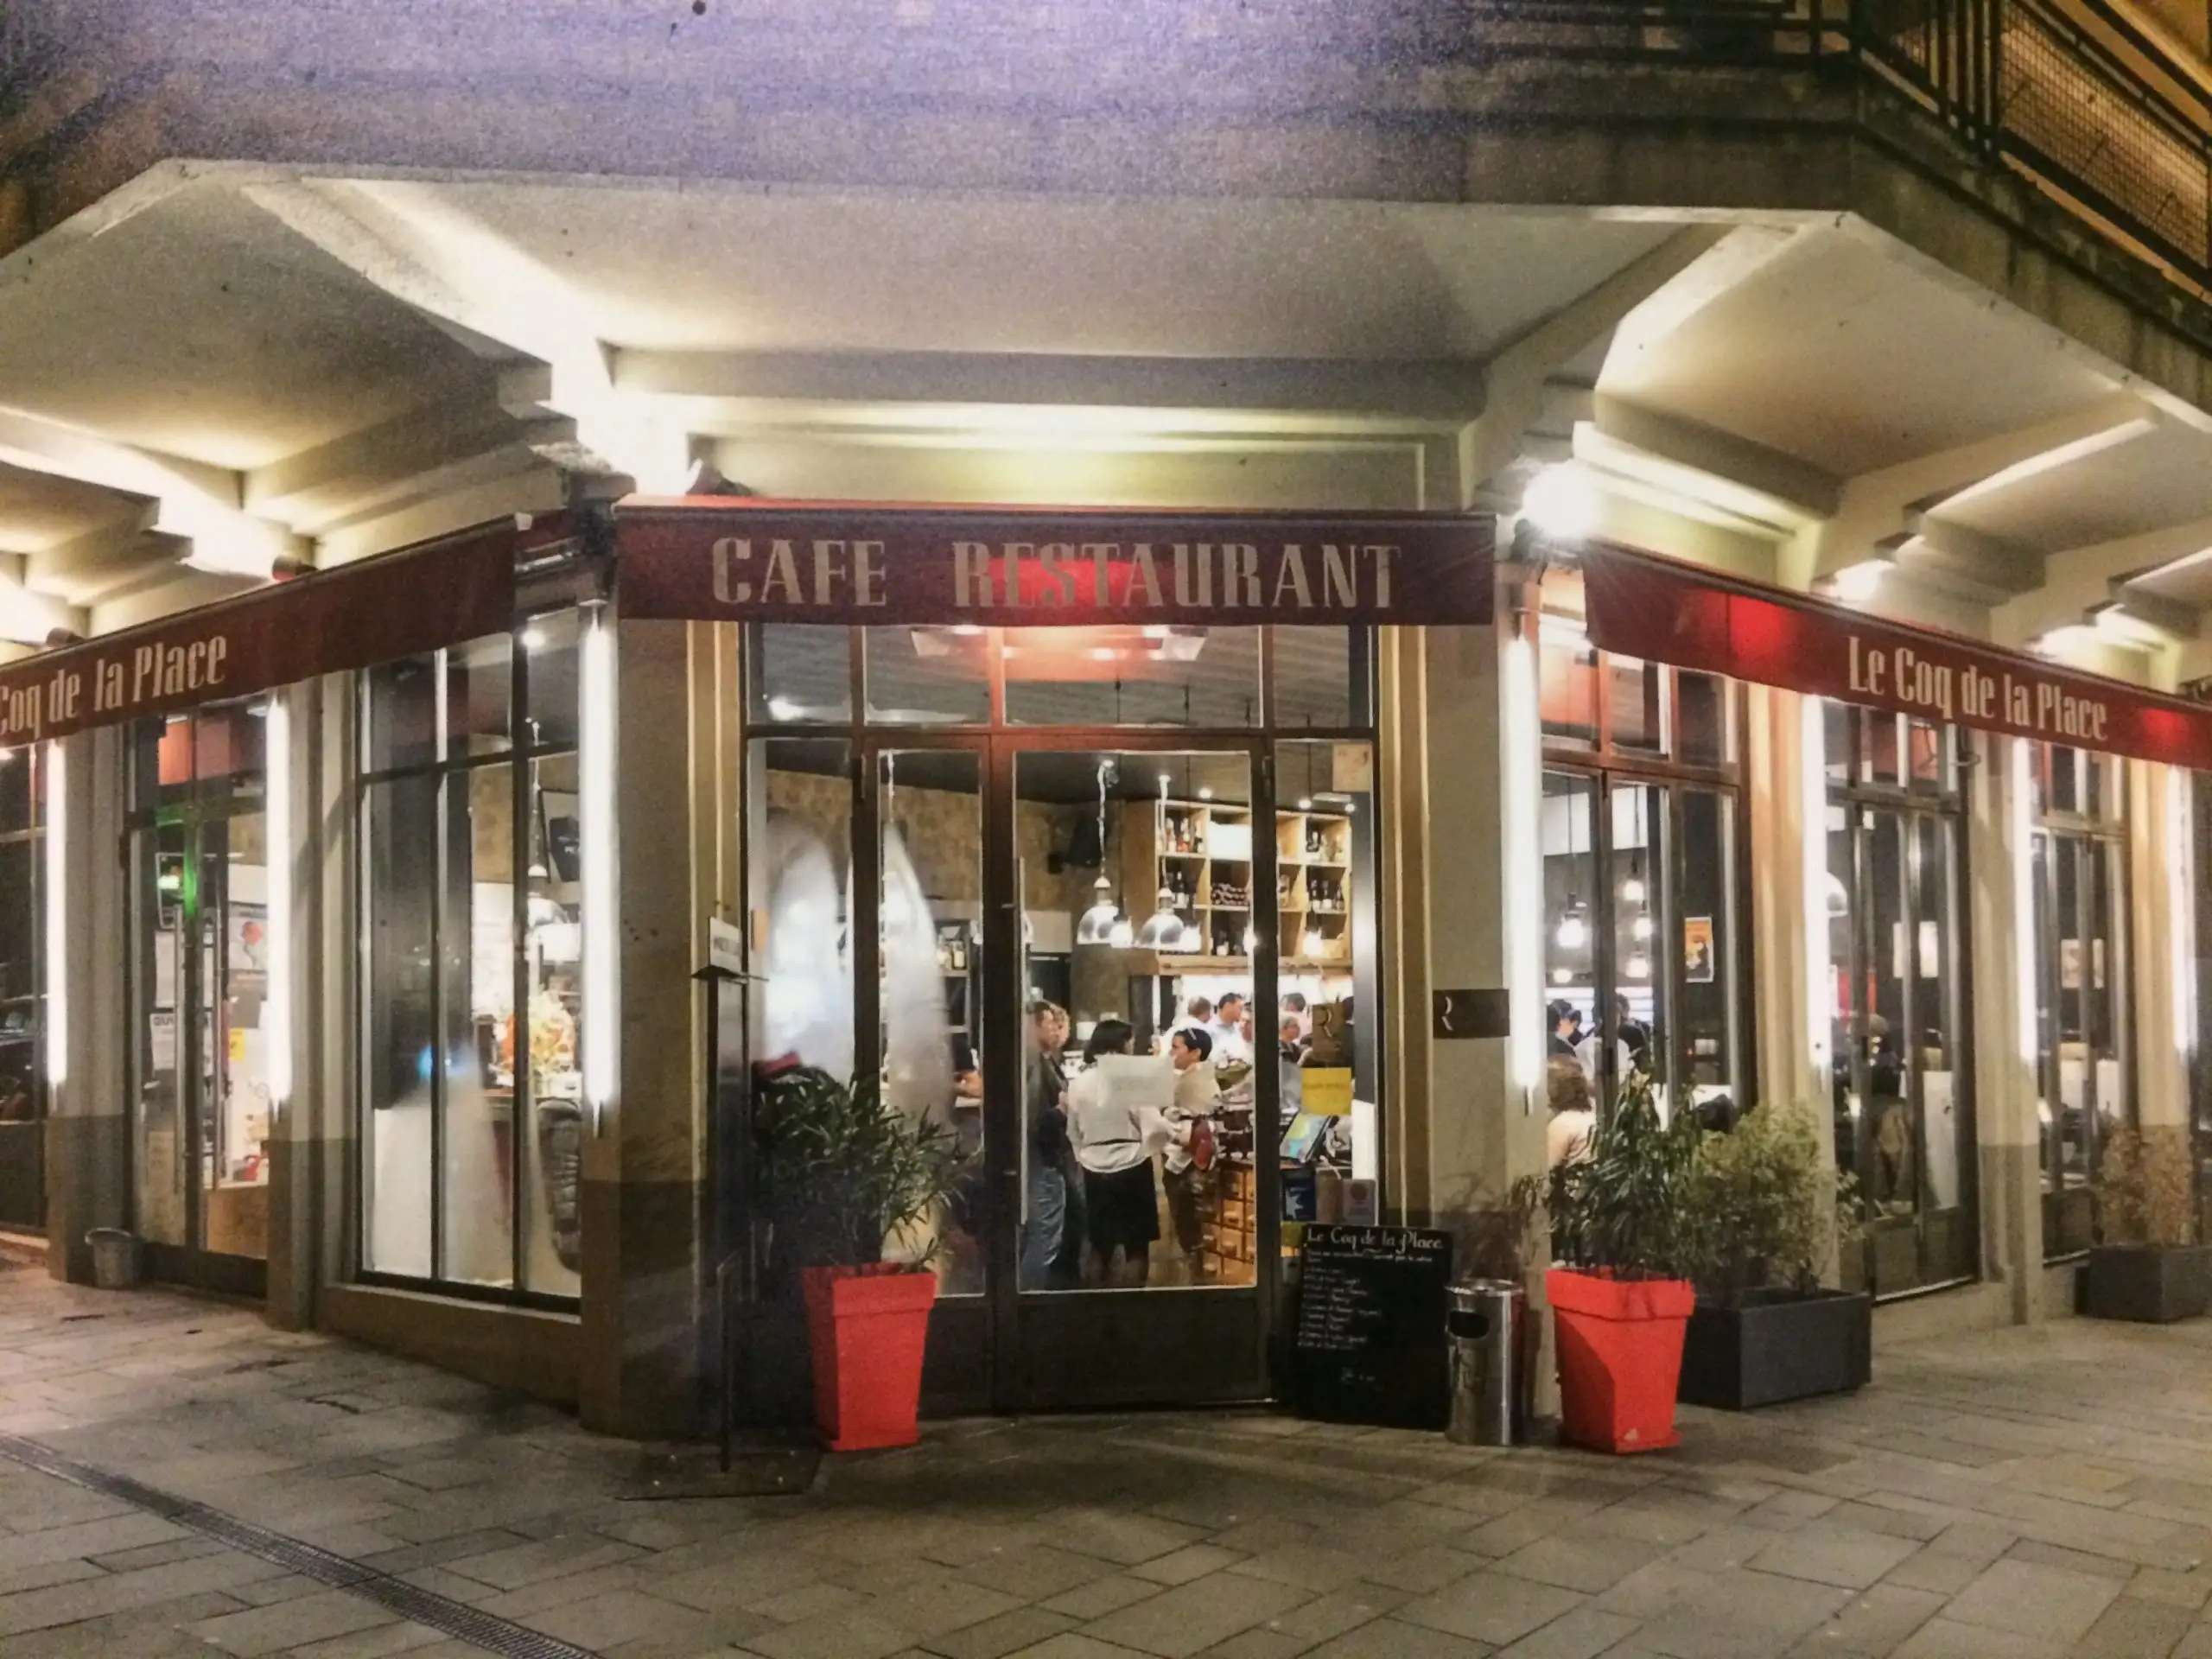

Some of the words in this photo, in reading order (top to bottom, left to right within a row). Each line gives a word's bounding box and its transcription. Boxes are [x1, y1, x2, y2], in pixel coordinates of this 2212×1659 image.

[712, 537, 887, 607] CAFE
[950, 541, 1402, 609] RESTAURANT
[48, 668, 81, 723] de
[93, 658, 124, 713] la
[131, 634, 227, 703] Place
[1849, 636, 1886, 696] Le
[1894, 647, 1953, 720] Coq
[1960, 664, 1996, 719] de
[2003, 673, 2031, 727] la
[2036, 681, 2109, 741] Place
[1306, 1228, 1325, 1242] Le
[1330, 1226, 1357, 1250] Coq
[1360, 1229, 1376, 1245] de
[1382, 1230, 1396, 1247] la
[1395, 1230, 1445, 1254] Place
